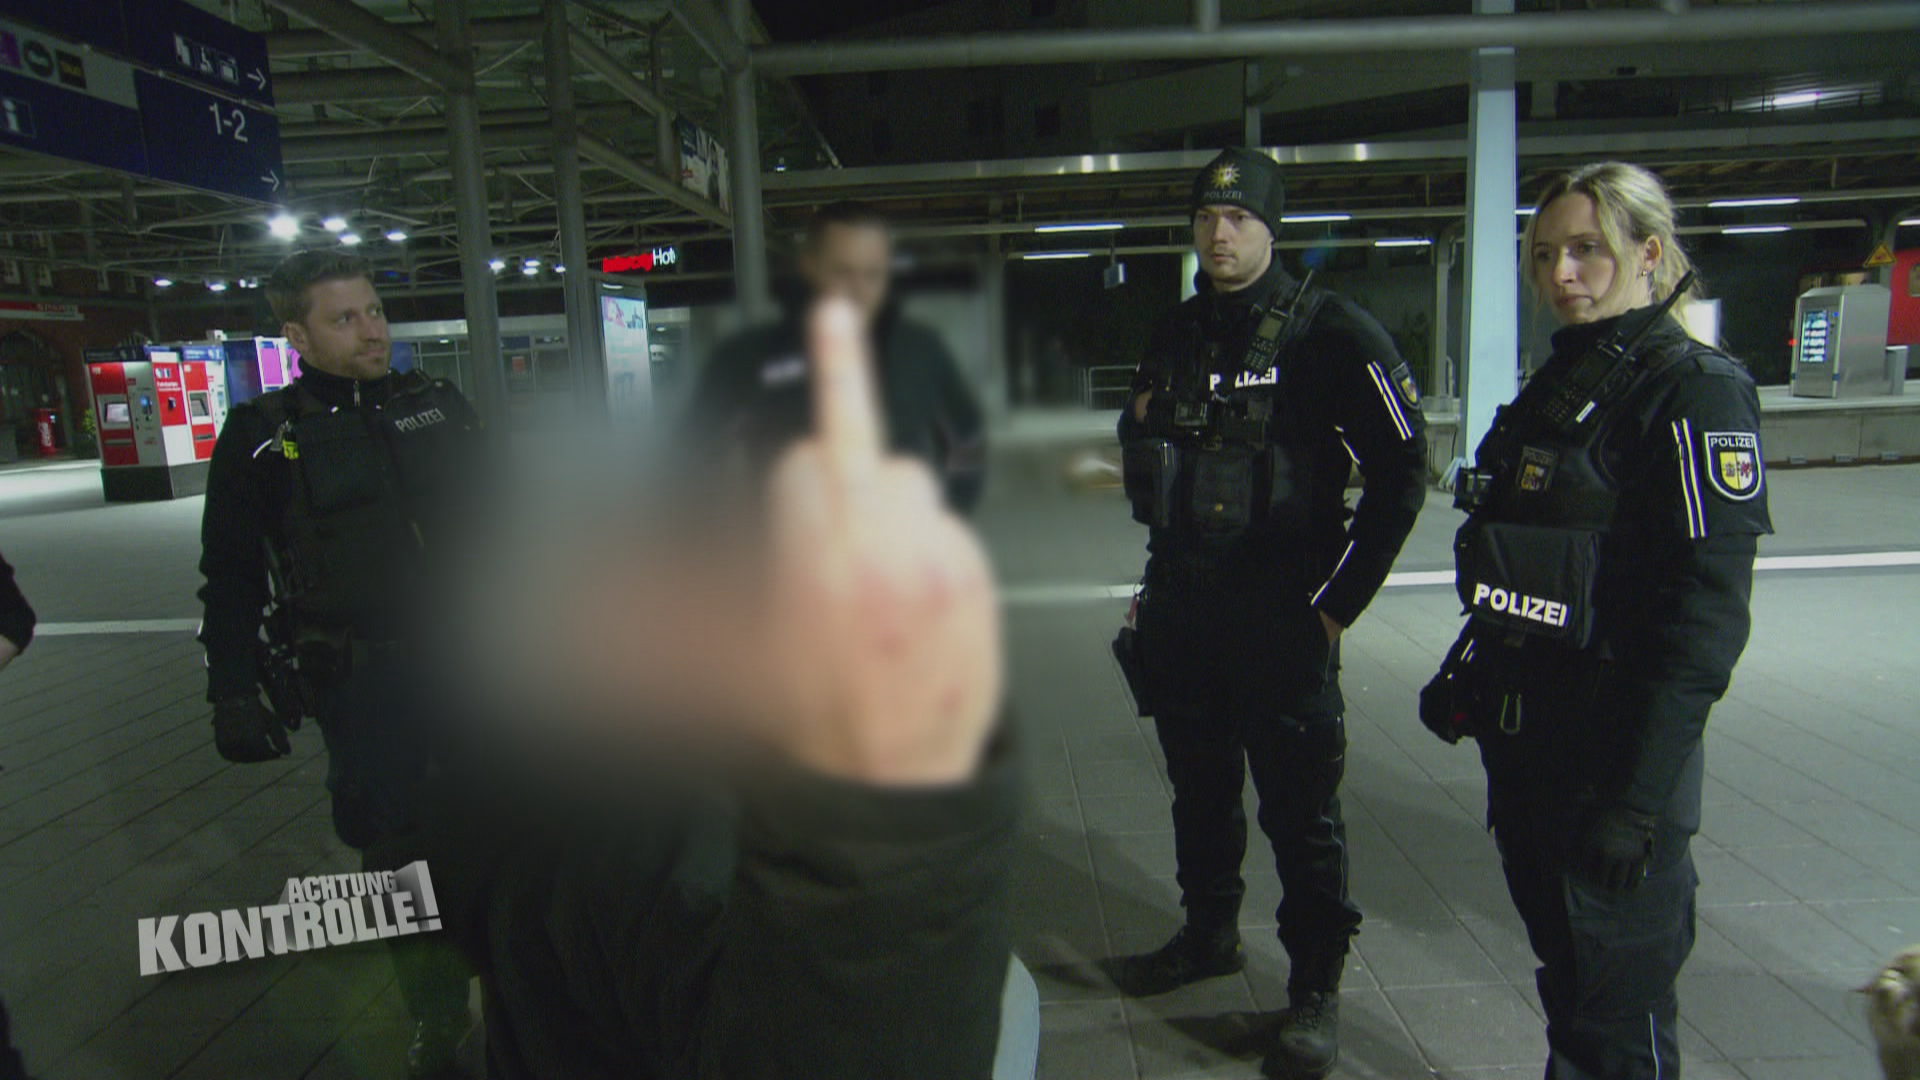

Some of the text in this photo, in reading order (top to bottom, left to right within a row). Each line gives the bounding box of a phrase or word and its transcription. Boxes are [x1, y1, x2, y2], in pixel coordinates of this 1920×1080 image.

[209, 102, 248, 143] 1-2
[1204, 191, 1241, 200] POLIZEI
[1209, 367, 1278, 391] PLIZEI
[395, 408, 446, 432] POLIZEI
[1710, 436, 1754, 448] POLIZEI
[1473, 583, 1567, 627] POLIZEI
